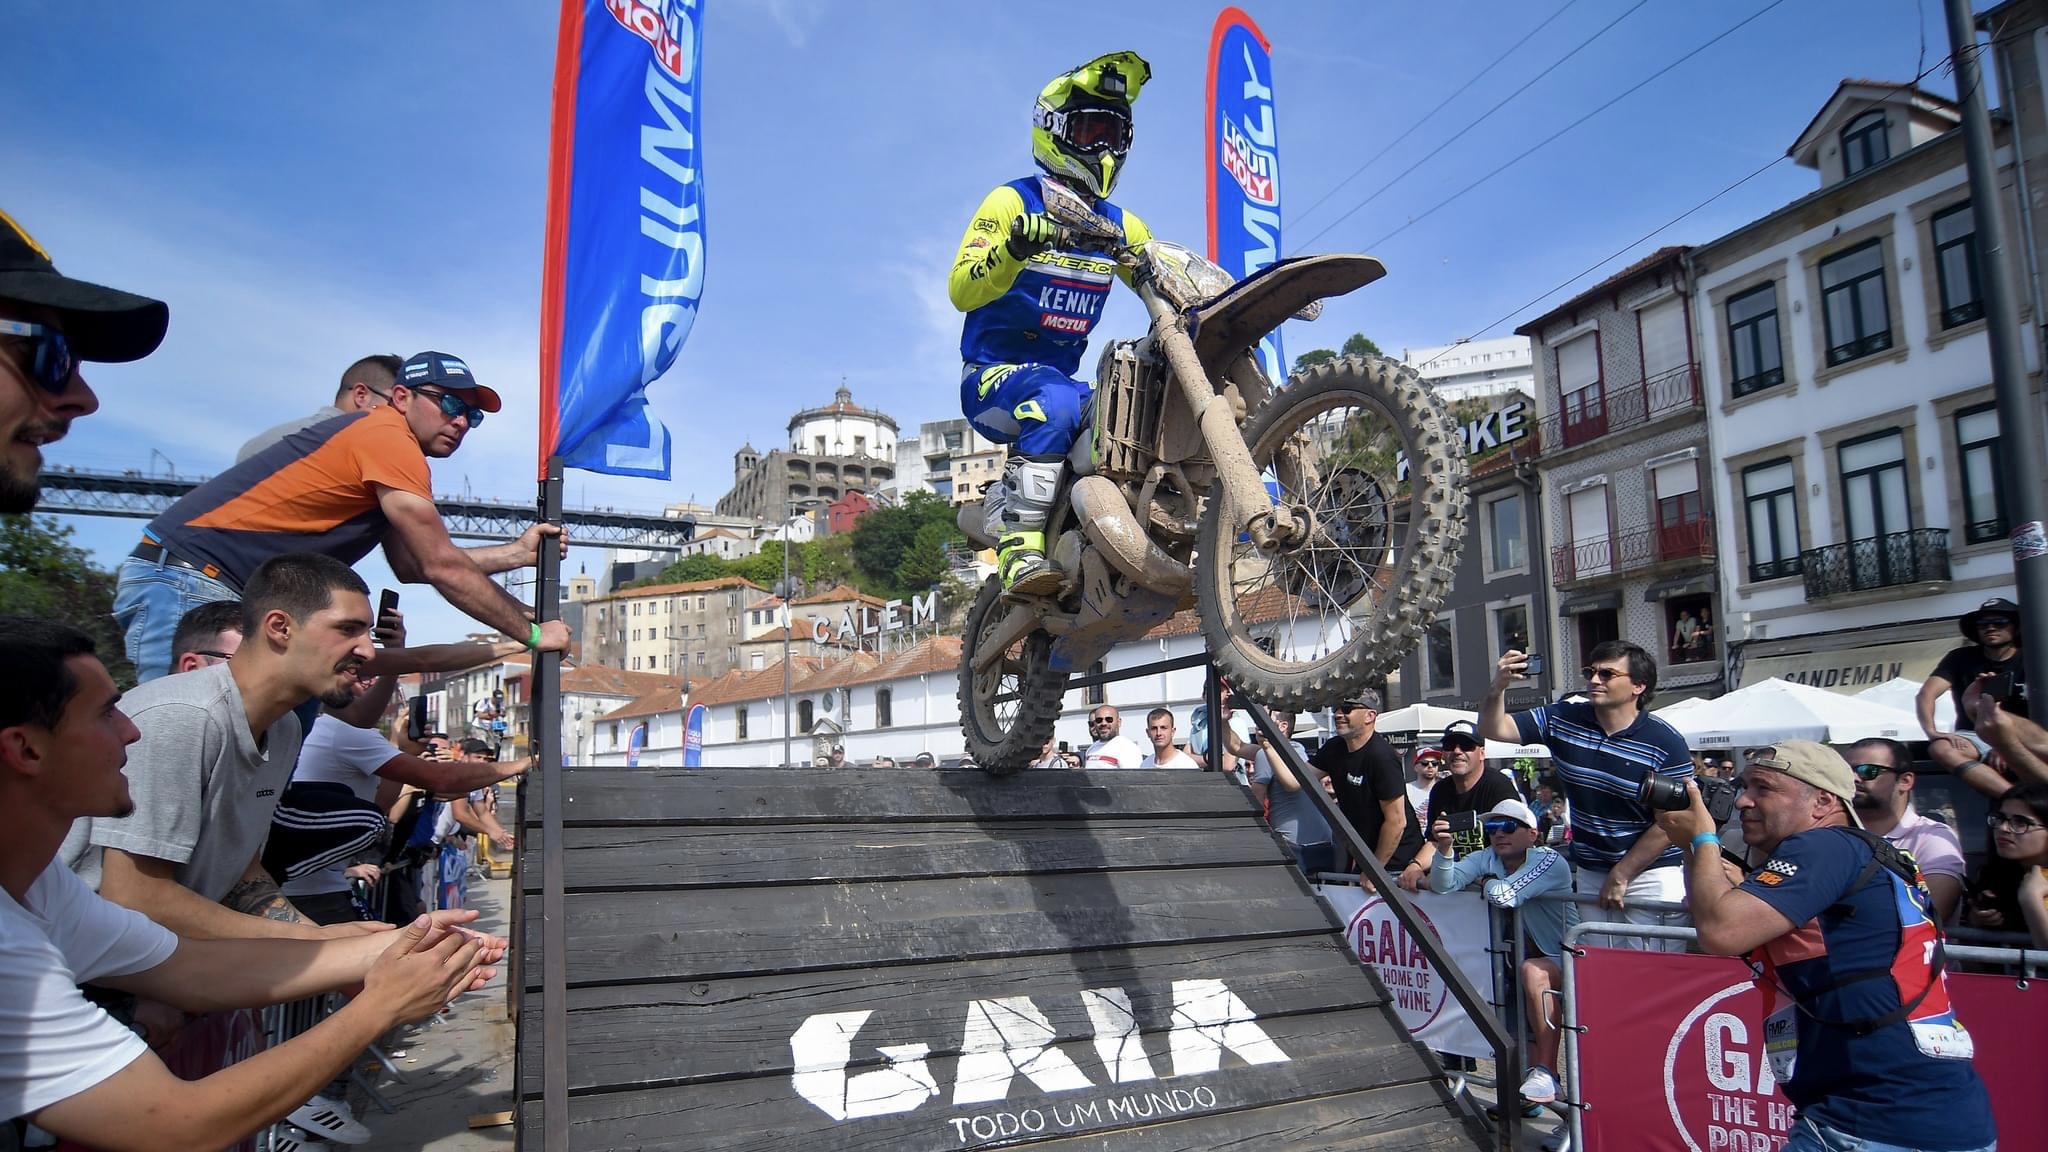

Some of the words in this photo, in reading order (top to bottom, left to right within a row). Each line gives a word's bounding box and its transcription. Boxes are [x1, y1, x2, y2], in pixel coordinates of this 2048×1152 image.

[1223, 117, 1267, 177] LIQUI
[1223, 141, 1271, 200] MOLY
[1039, 286, 1101, 315] KENNY
[1043, 314, 1090, 333] MOTUL
[1785, 662, 1903, 689] SANDEMAN
[1357, 918, 1429, 970] GAIA
[1383, 968, 1414, 988] HOME
[1415, 972, 1430, 990] OF
[1397, 988, 1432, 1013] WINE
[789, 979, 1293, 1121] GAIA
[948, 1109, 1046, 1144] TODO
[1053, 1100, 1102, 1128] UM
[1107, 1086, 1217, 1121] MUNDO
[1707, 1093, 1759, 1127] THE
